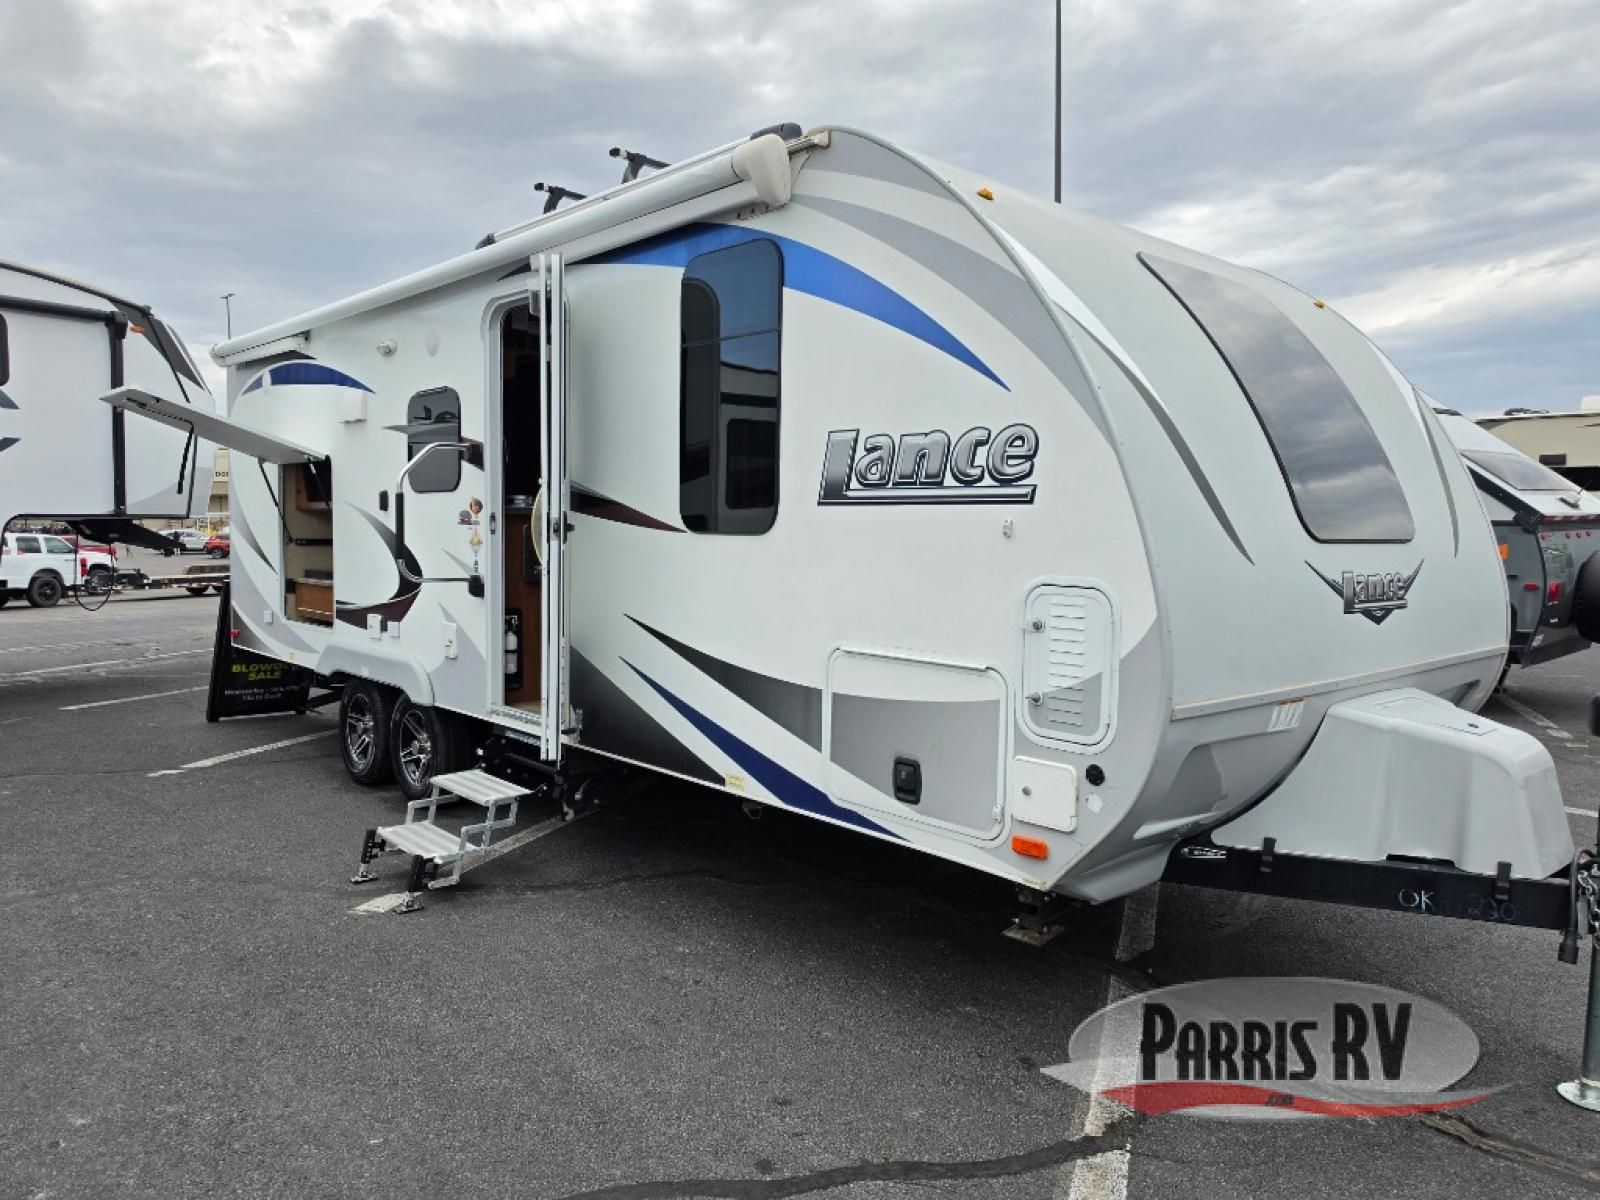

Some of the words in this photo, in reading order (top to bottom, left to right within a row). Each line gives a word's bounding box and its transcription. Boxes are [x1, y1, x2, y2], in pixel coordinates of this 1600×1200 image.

[817, 423, 1039, 506] Lance
[1342, 570, 1408, 614] Lance
[231, 662, 290, 673] BLOWO
[248, 671, 283, 681] SALE
[1398, 888, 1434, 913] OK
